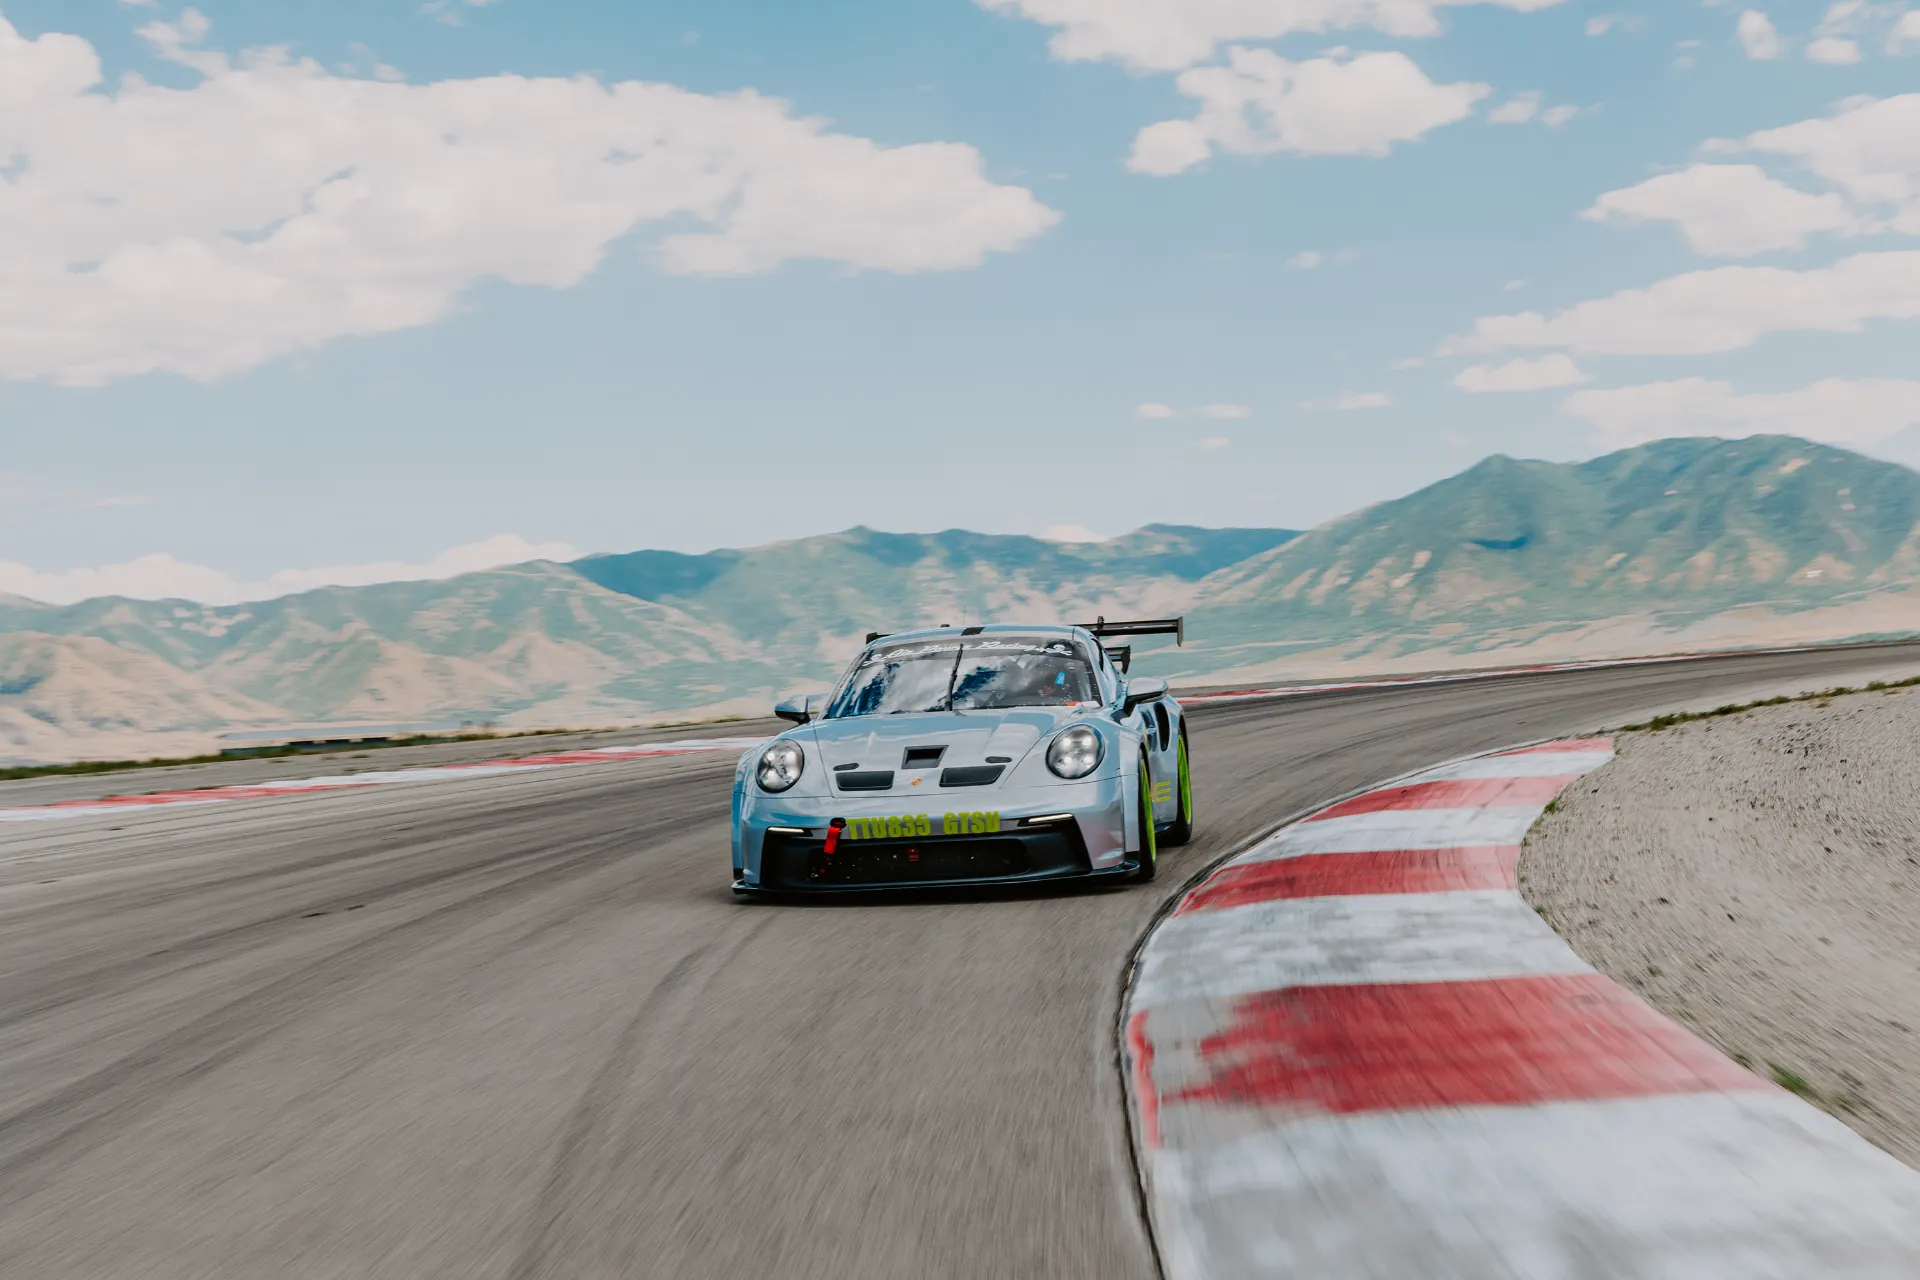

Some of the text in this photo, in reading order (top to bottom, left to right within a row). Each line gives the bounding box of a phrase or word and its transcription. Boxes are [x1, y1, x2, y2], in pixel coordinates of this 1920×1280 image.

[975, 641, 1037, 652] Racing
[846, 810, 1000, 840] TTU835 GTSU
